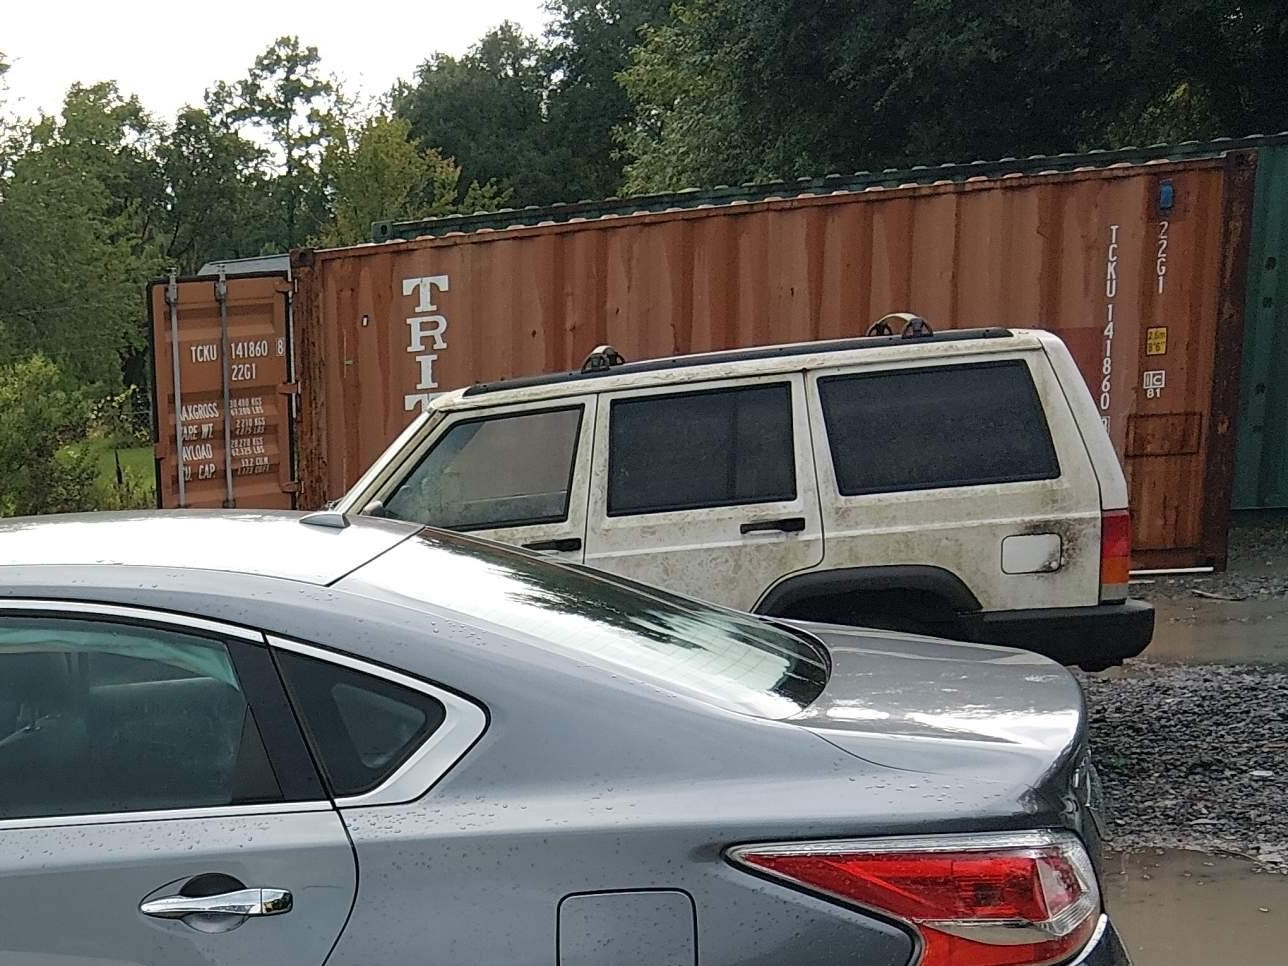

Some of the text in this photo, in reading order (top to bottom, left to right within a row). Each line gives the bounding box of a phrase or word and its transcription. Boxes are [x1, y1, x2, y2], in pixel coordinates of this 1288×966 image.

[1106, 225, 1119, 297] TCKU
[1156, 222, 1168, 294] 22G1
[191, 339, 284, 363] TCKU 141860 8
[1100, 304, 1115, 410] 141860
[231, 363, 256, 381] 22G1
[1147, 389, 1161, 398] 81
[180, 403, 219, 421] AXGROSS
[182, 425, 198, 441] ARE
[182, 443, 213, 462] AYLOAD
[183, 465, 193, 481] U.
